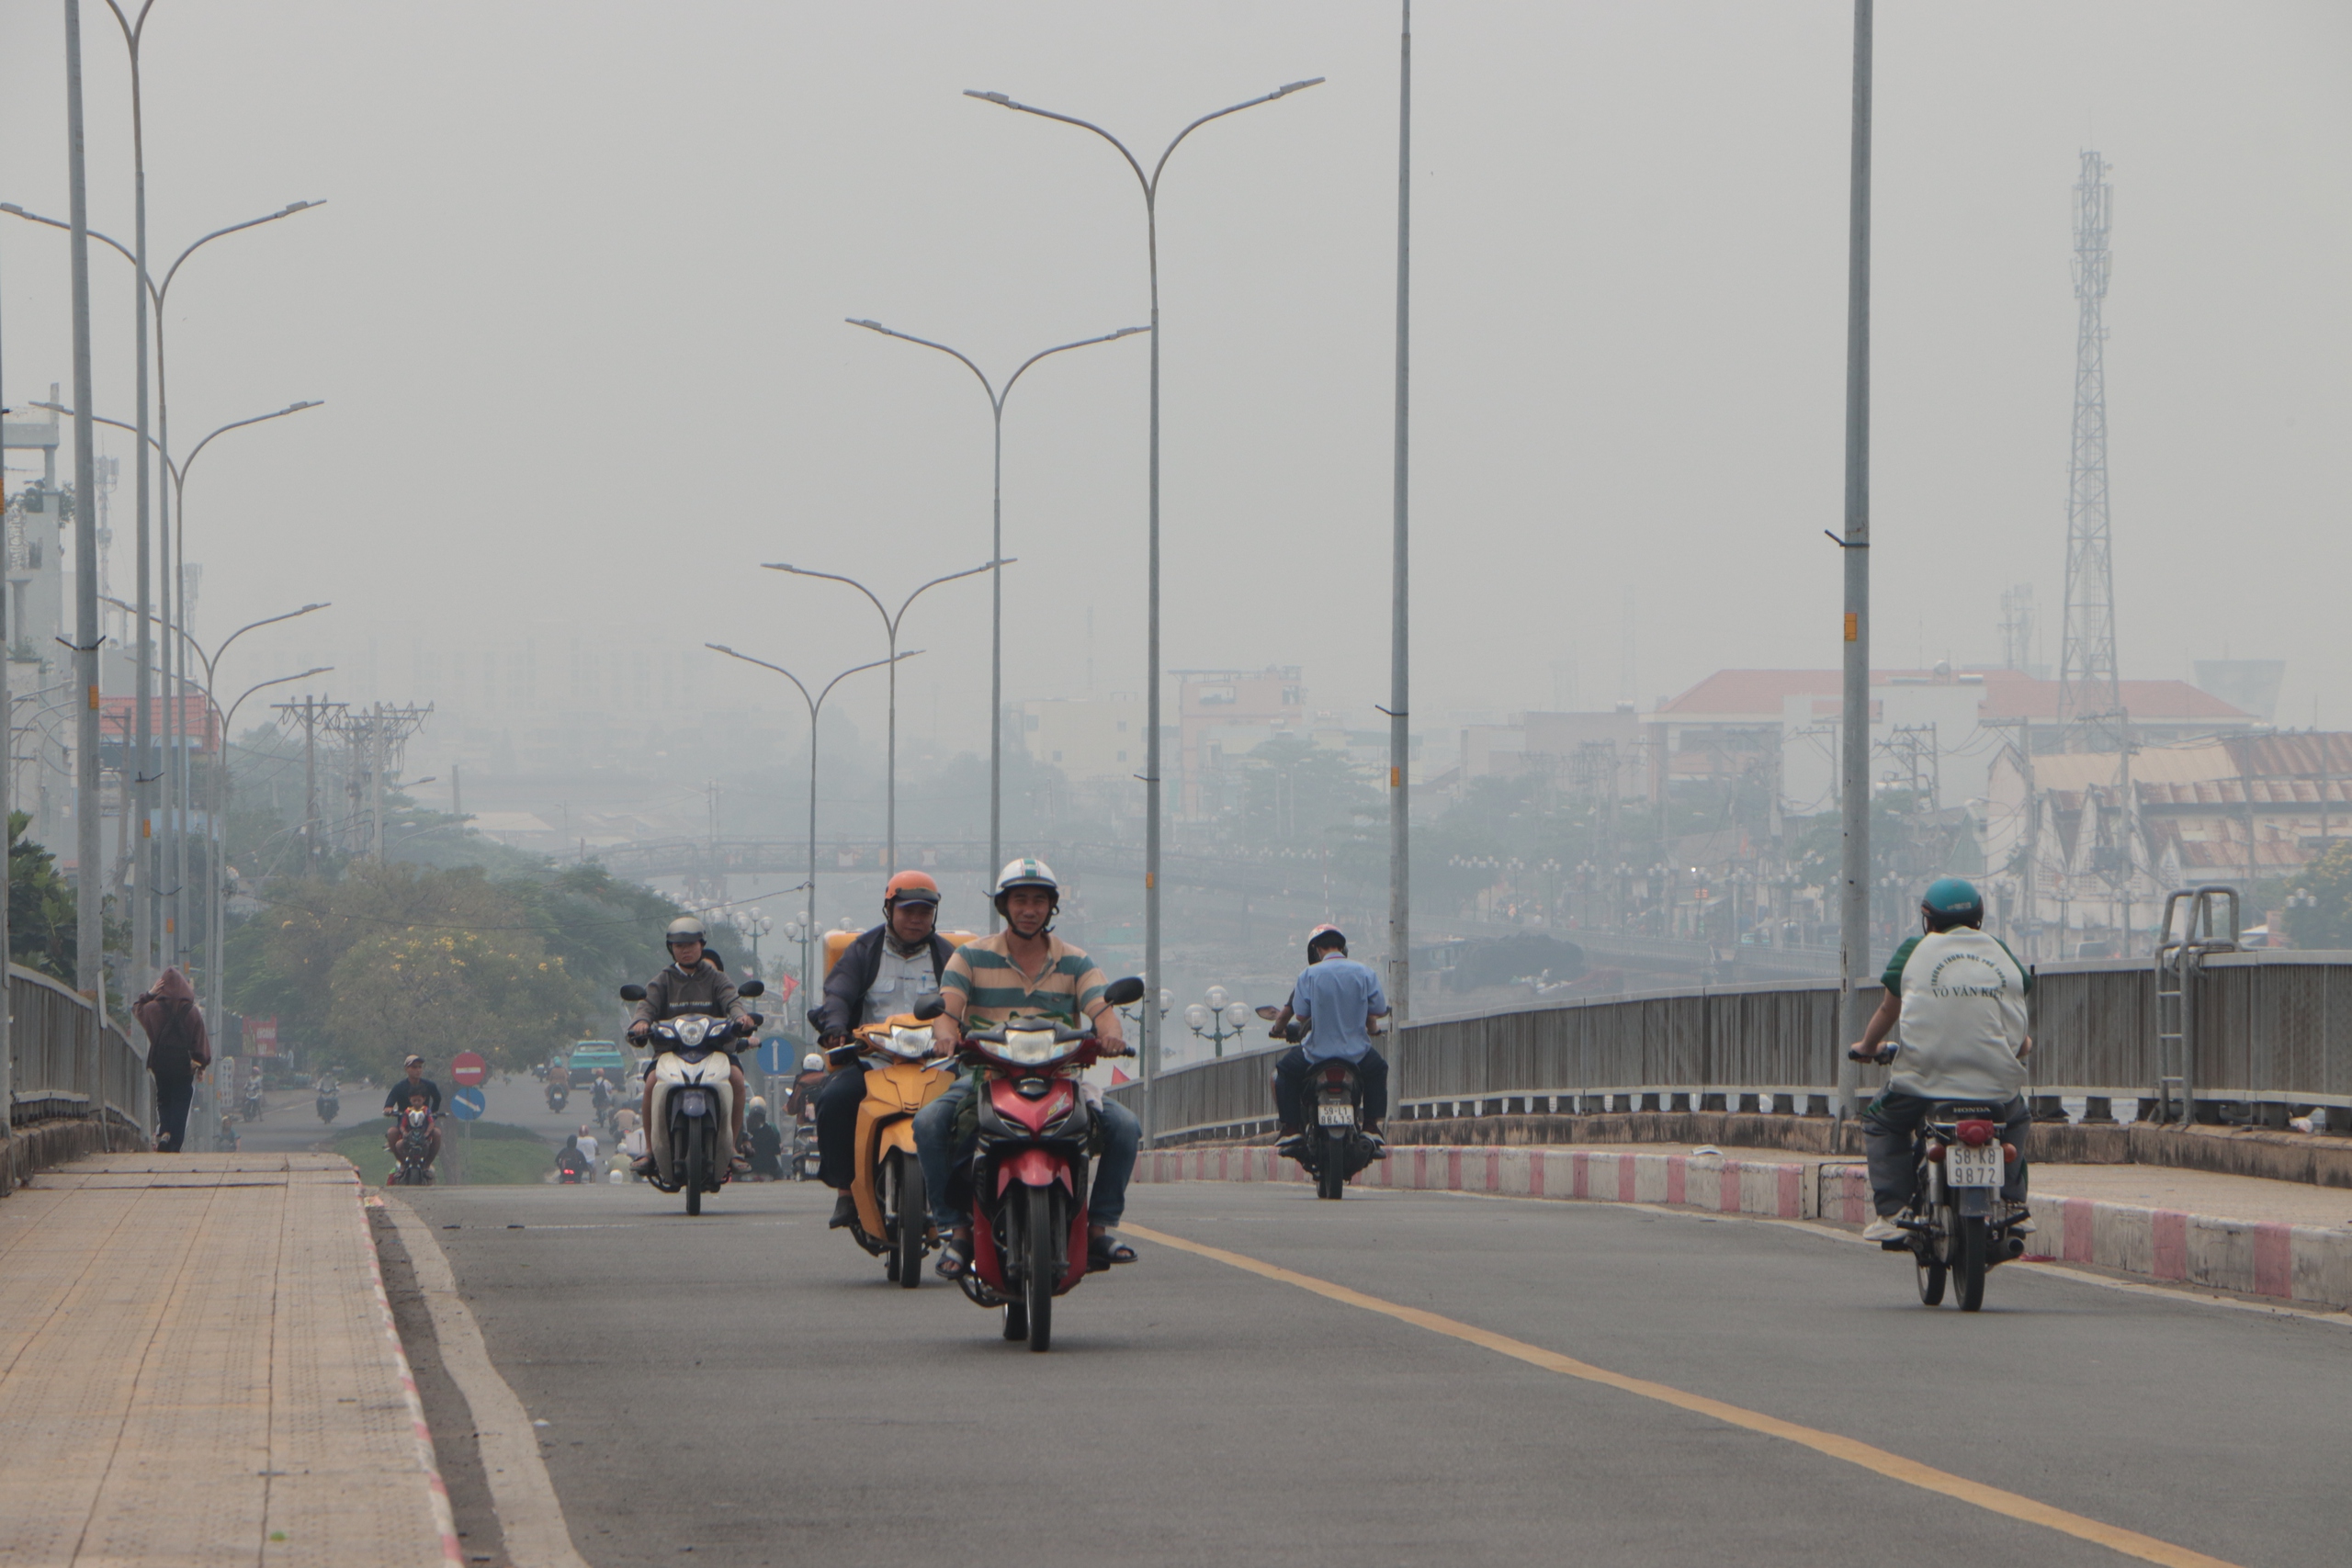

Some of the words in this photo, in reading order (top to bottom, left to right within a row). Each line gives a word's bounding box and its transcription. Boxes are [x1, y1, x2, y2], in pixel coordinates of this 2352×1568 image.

[1943, 953, 1965, 965] TRUNG
[1932, 985, 1950, 998] VÕ
[1952, 984, 1978, 998] VĂN
[1955, 1168, 1996, 1184] 9872
